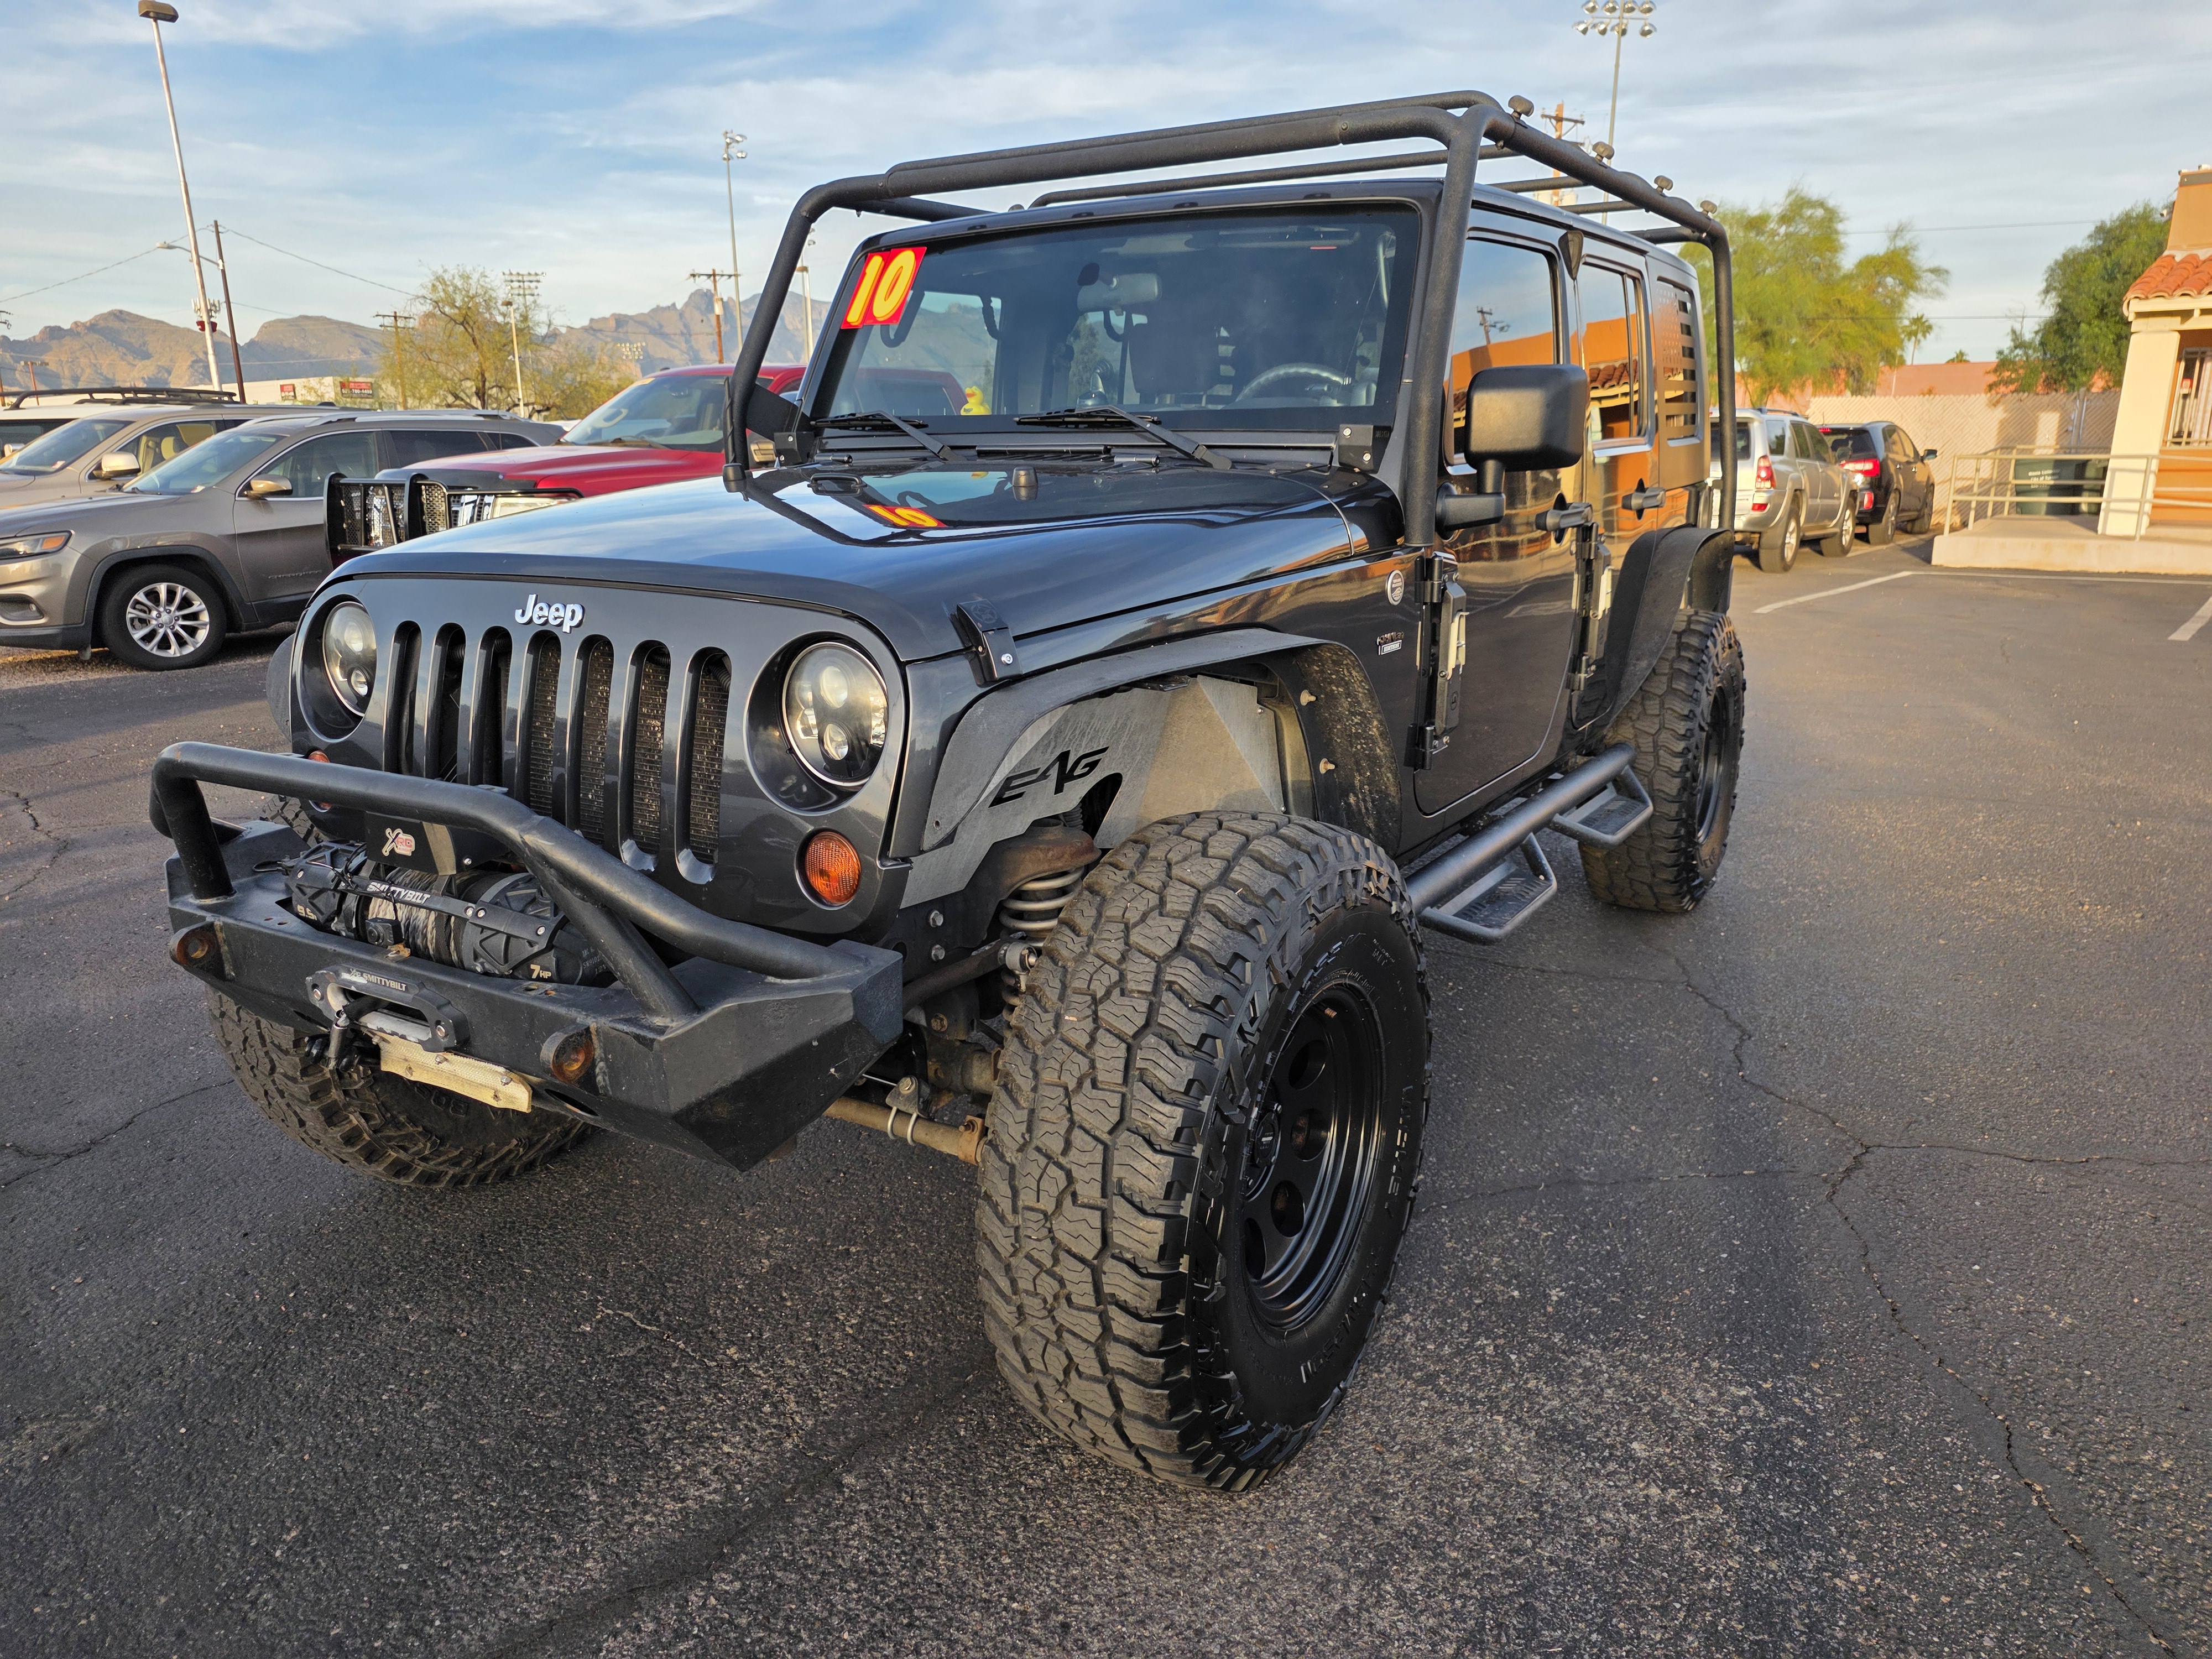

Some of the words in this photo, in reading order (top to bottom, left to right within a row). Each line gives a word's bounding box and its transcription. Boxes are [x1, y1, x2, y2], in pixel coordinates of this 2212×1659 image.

[846, 249, 917, 326] 10
[515, 593, 585, 634] Jeep
[988, 746, 1110, 808] EAG
[362, 972, 406, 992] SMITTYBILT
